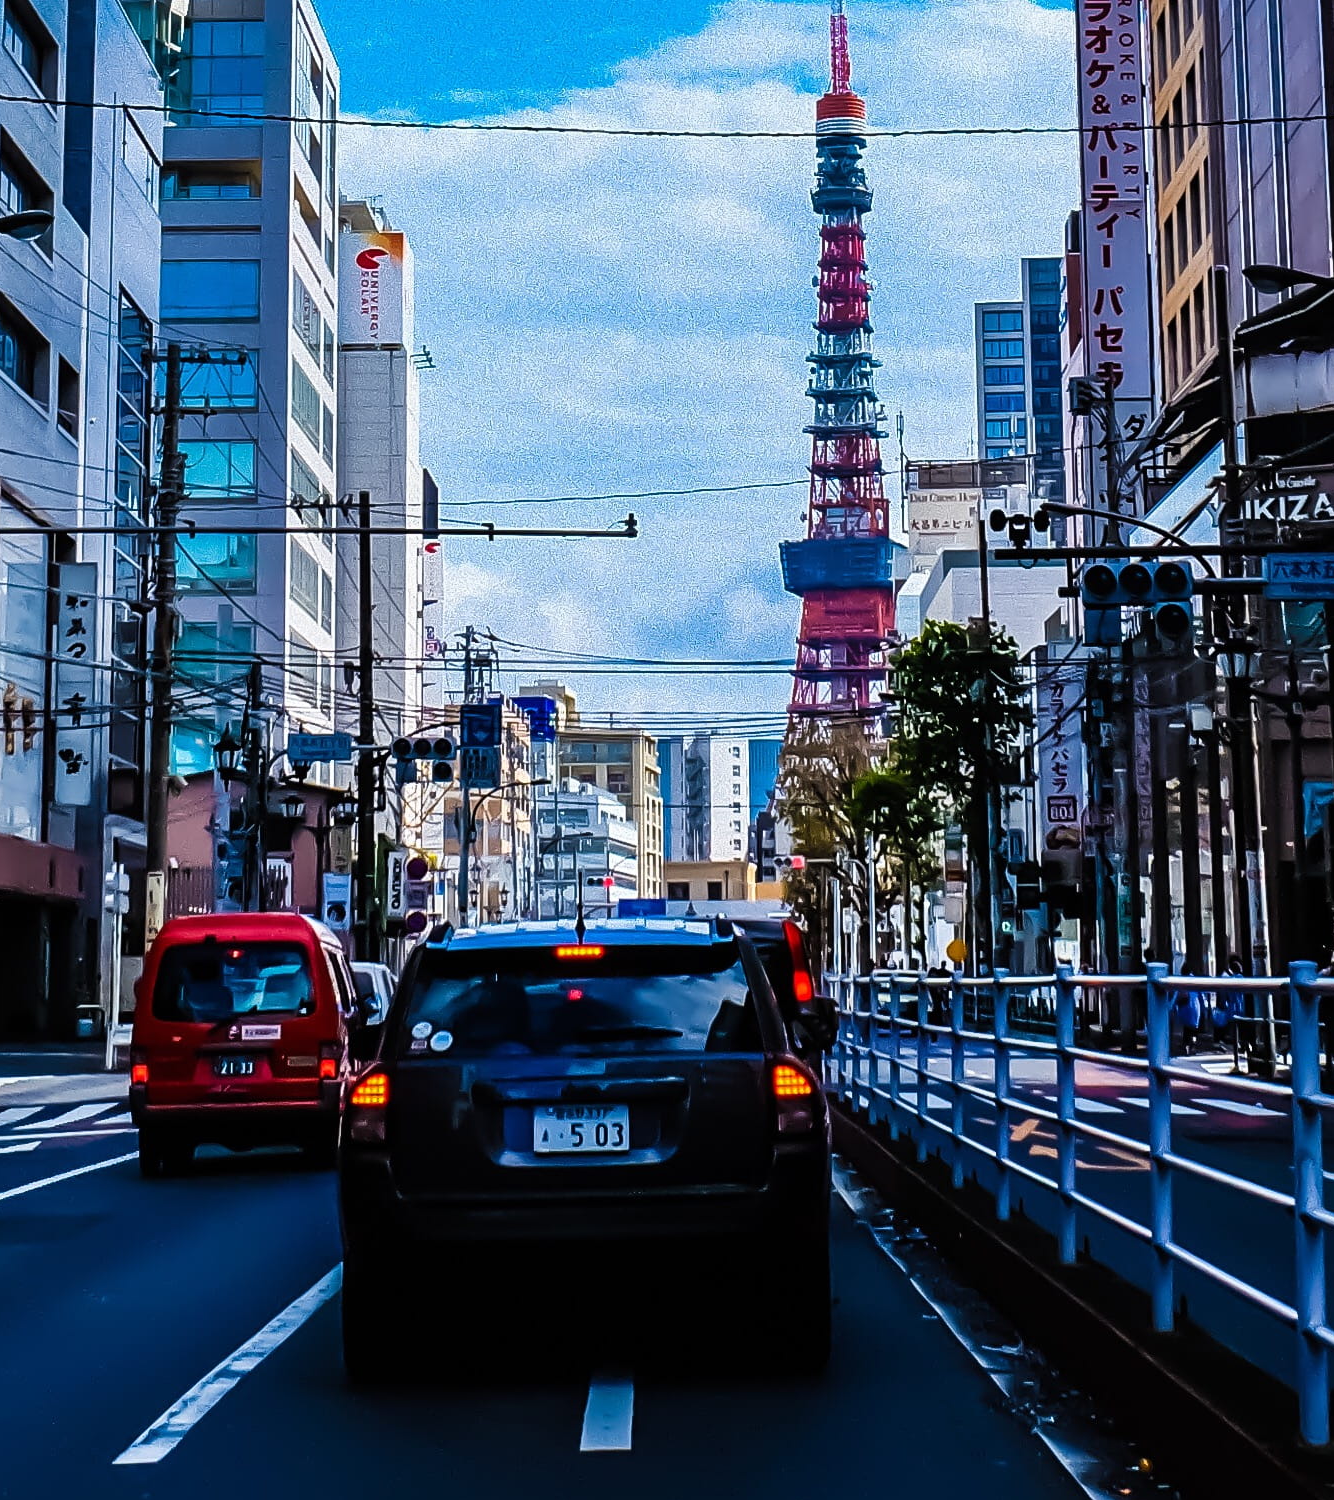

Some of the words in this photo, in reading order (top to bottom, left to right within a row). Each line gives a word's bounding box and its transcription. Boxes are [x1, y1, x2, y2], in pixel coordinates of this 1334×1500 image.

[1120, 93, 1137, 105] &
[1122, 121, 1141, 220] PARTY
[360, 270, 370, 315] SOLAR
[370, 270, 379, 340] UNIVERGY
